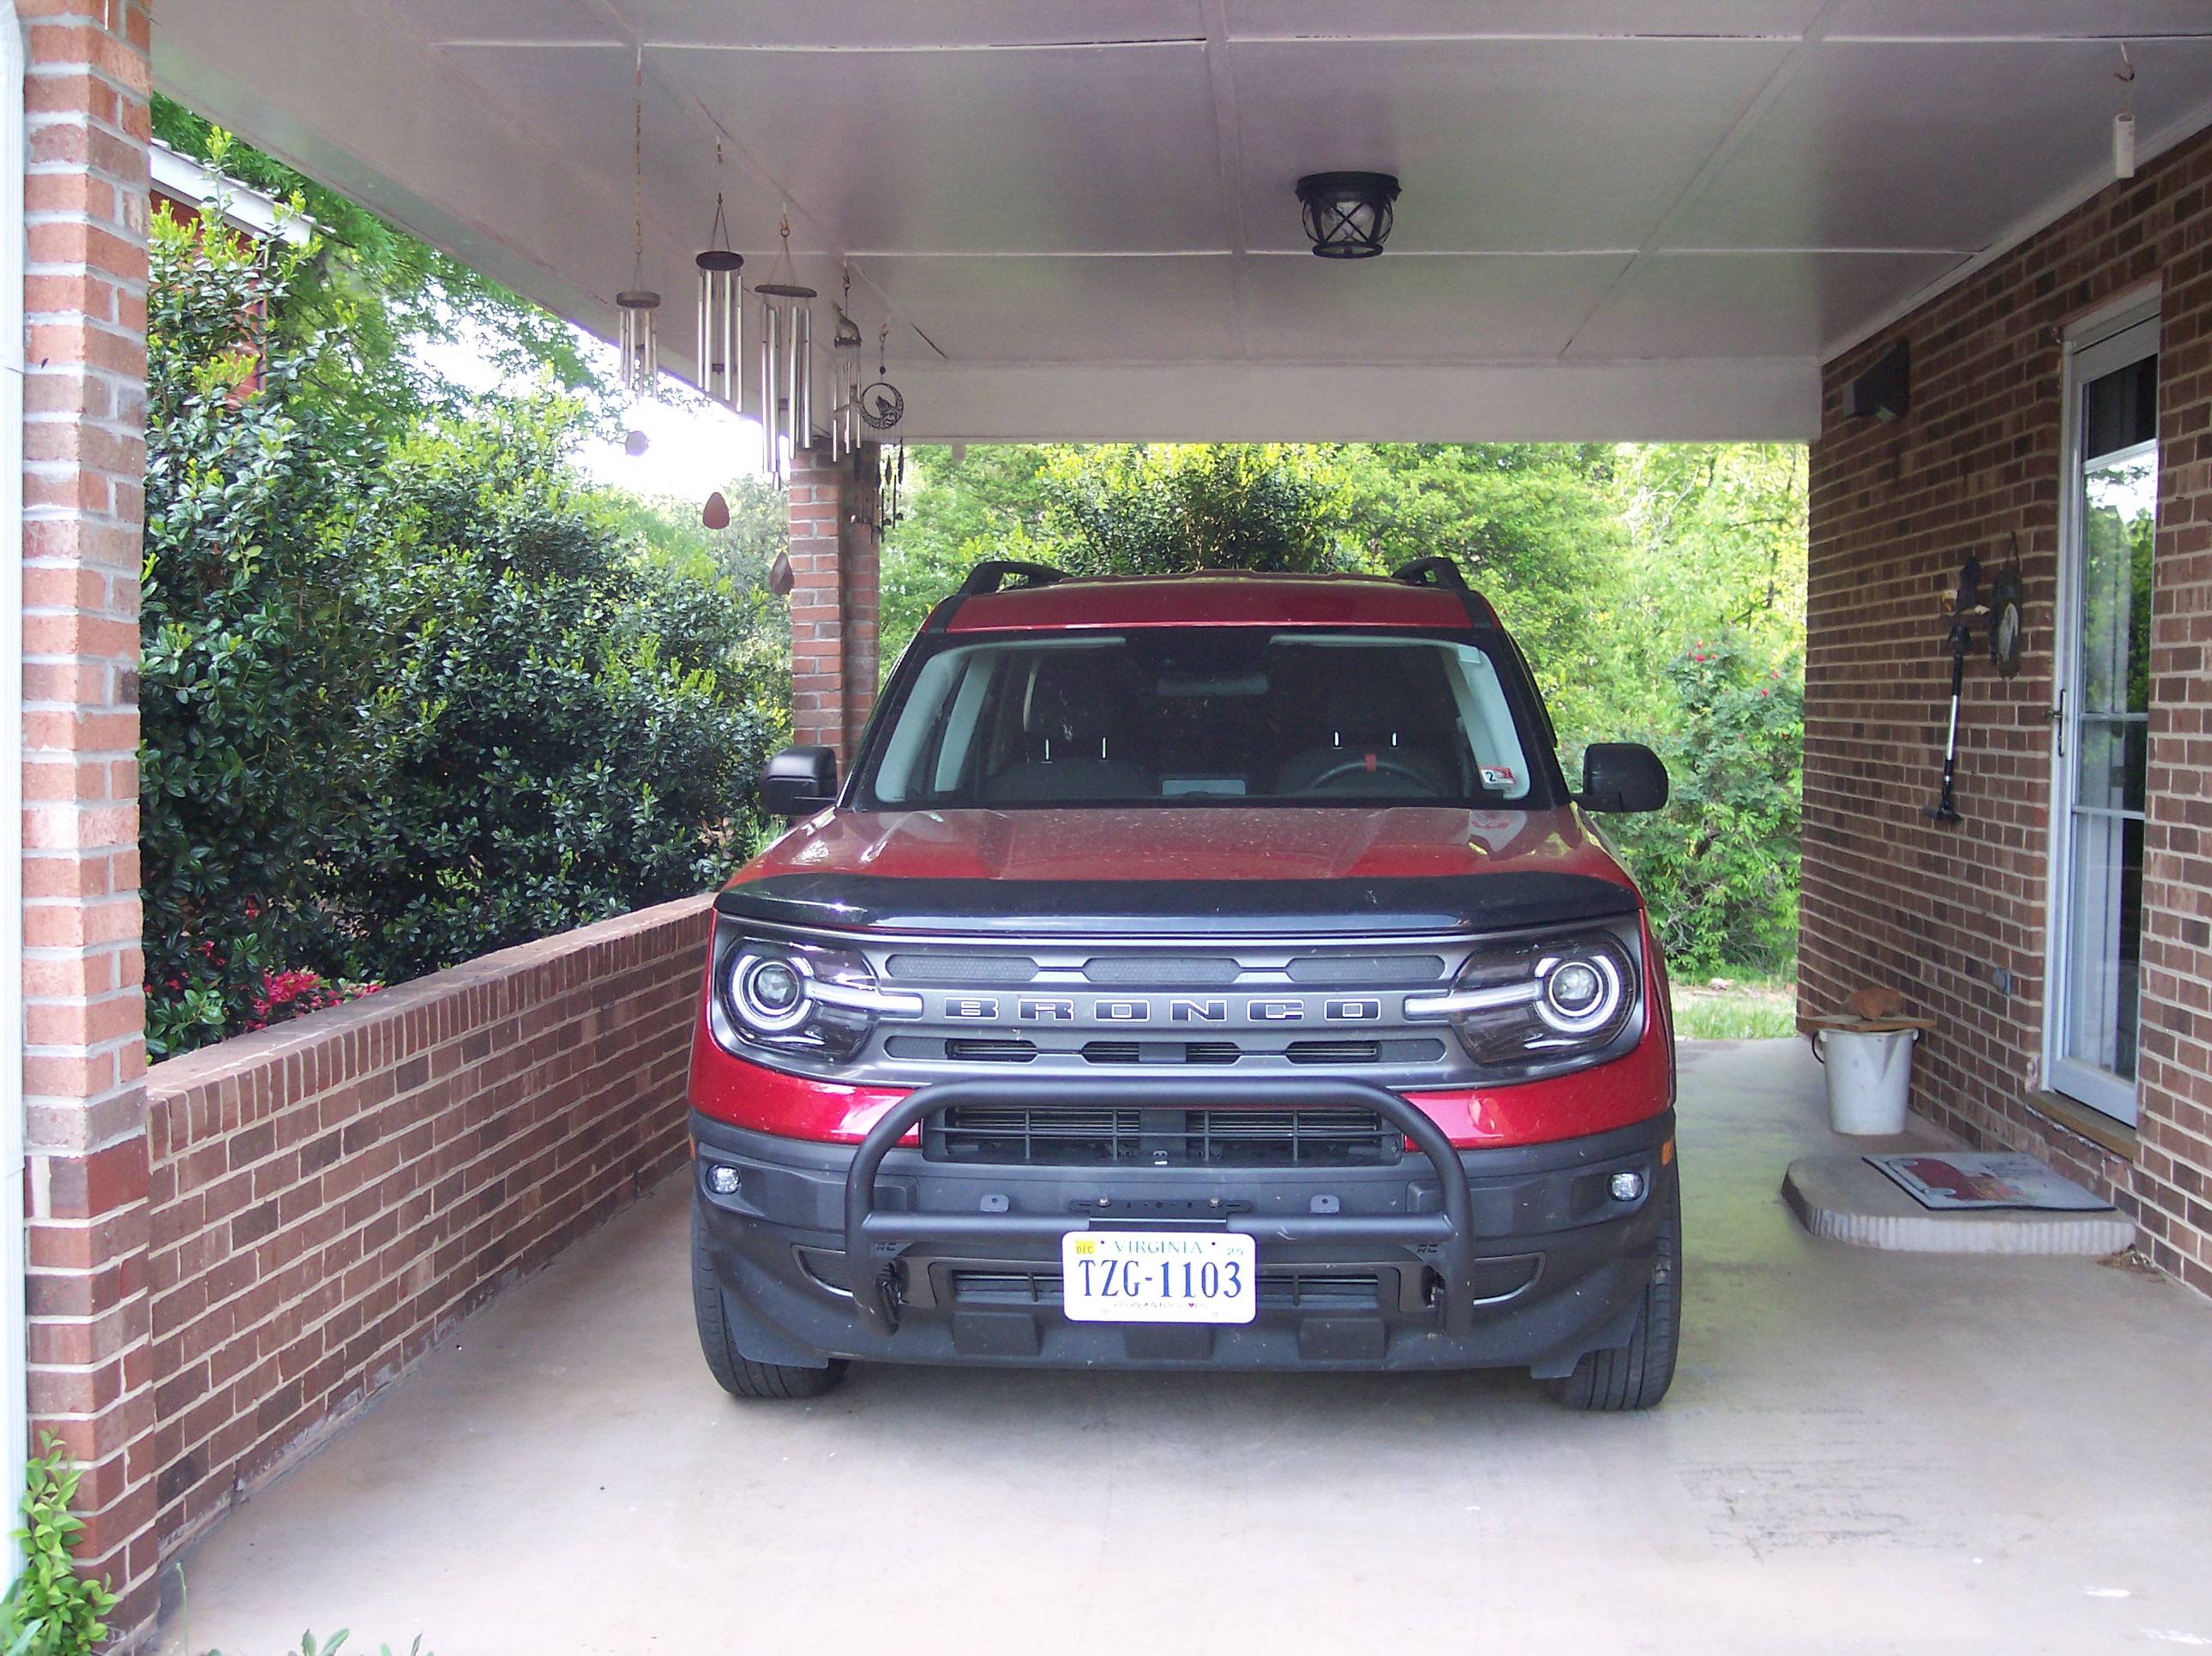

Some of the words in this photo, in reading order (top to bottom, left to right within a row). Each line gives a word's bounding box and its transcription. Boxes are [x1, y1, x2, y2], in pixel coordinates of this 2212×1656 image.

[943, 995, 1382, 1023] BRONCO
[1076, 1245, 1093, 1254] DEC
[1114, 1239, 1203, 1255] VIRGINIA
[1078, 1259, 1242, 1299] TZG-1103
